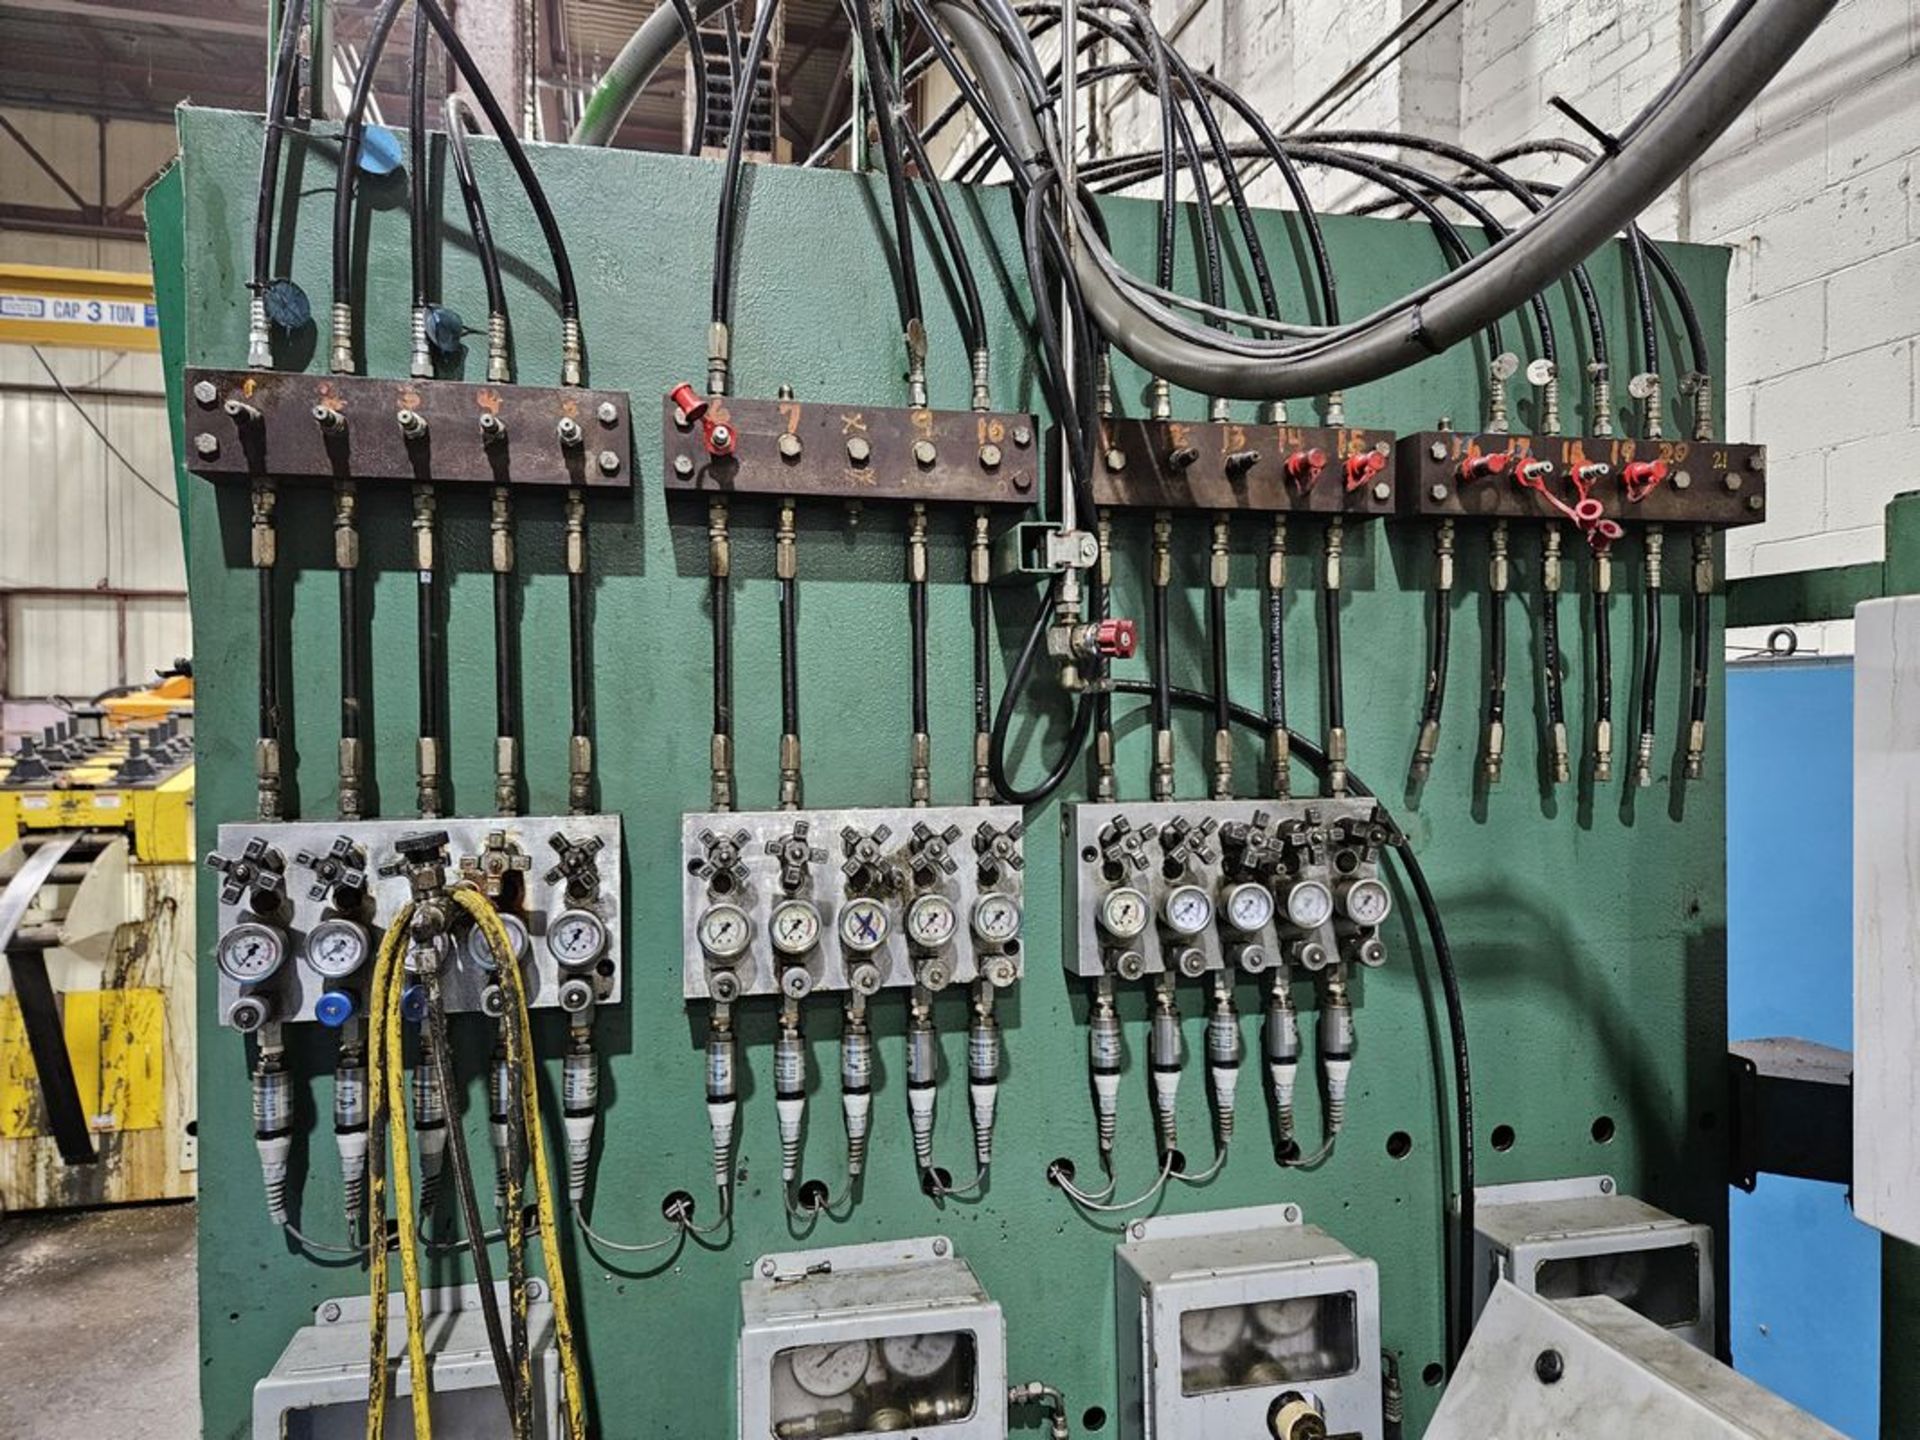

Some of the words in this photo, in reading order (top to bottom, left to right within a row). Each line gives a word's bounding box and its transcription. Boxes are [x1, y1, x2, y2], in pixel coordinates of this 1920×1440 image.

[53, 300, 81, 319] CAP
[87, 301, 102, 323] 3
[109, 304, 136, 323] TON
[779, 402, 801, 434] 7
[910, 409, 934, 438] 9
[977, 415, 1005, 447] 10
[1610, 440, 1636, 466] 19
[1712, 450, 1728, 470] 21
